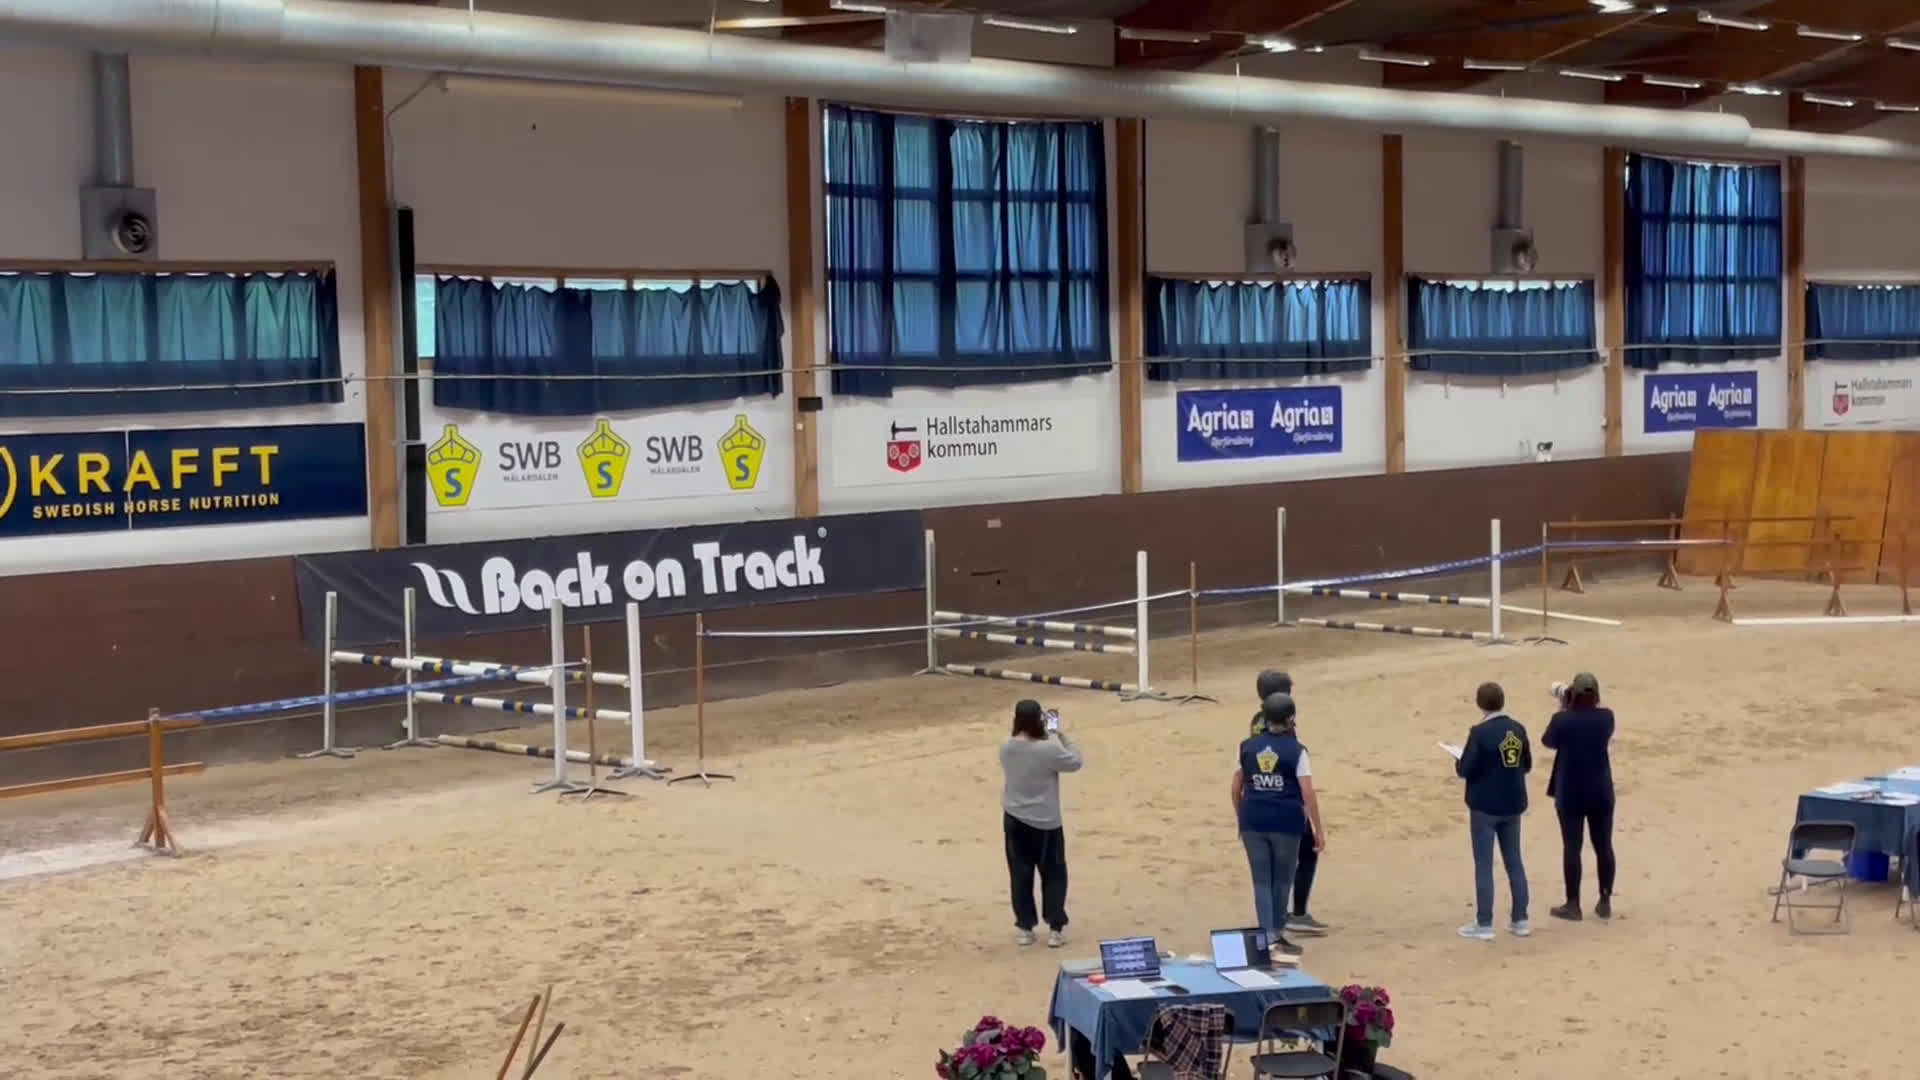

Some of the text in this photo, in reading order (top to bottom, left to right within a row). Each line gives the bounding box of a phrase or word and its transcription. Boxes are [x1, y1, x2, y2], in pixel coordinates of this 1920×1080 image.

[1650, 384, 1688, 414] Agria
[1707, 382, 1744, 412] Agria
[926, 415, 1053, 436] Hallstahammars
[1186, 402, 1240, 438] Agria
[1270, 399, 1321, 434] Agria
[498, 440, 562, 472] SWB
[645, 434, 704, 465] SWB
[927, 440, 998, 459] kommun
[30, 445, 279, 496] KRAFFT
[444, 467, 463, 499] S
[597, 461, 614, 490] S
[735, 454, 751, 482] S
[32, 492, 280, 520] SWEDISH HORSE NUTRITION
[481, 551, 614, 615] Back
[622, 558, 687, 602] on
[1506, 749, 1517, 764] S
[1252, 773, 1285, 788] SWB
